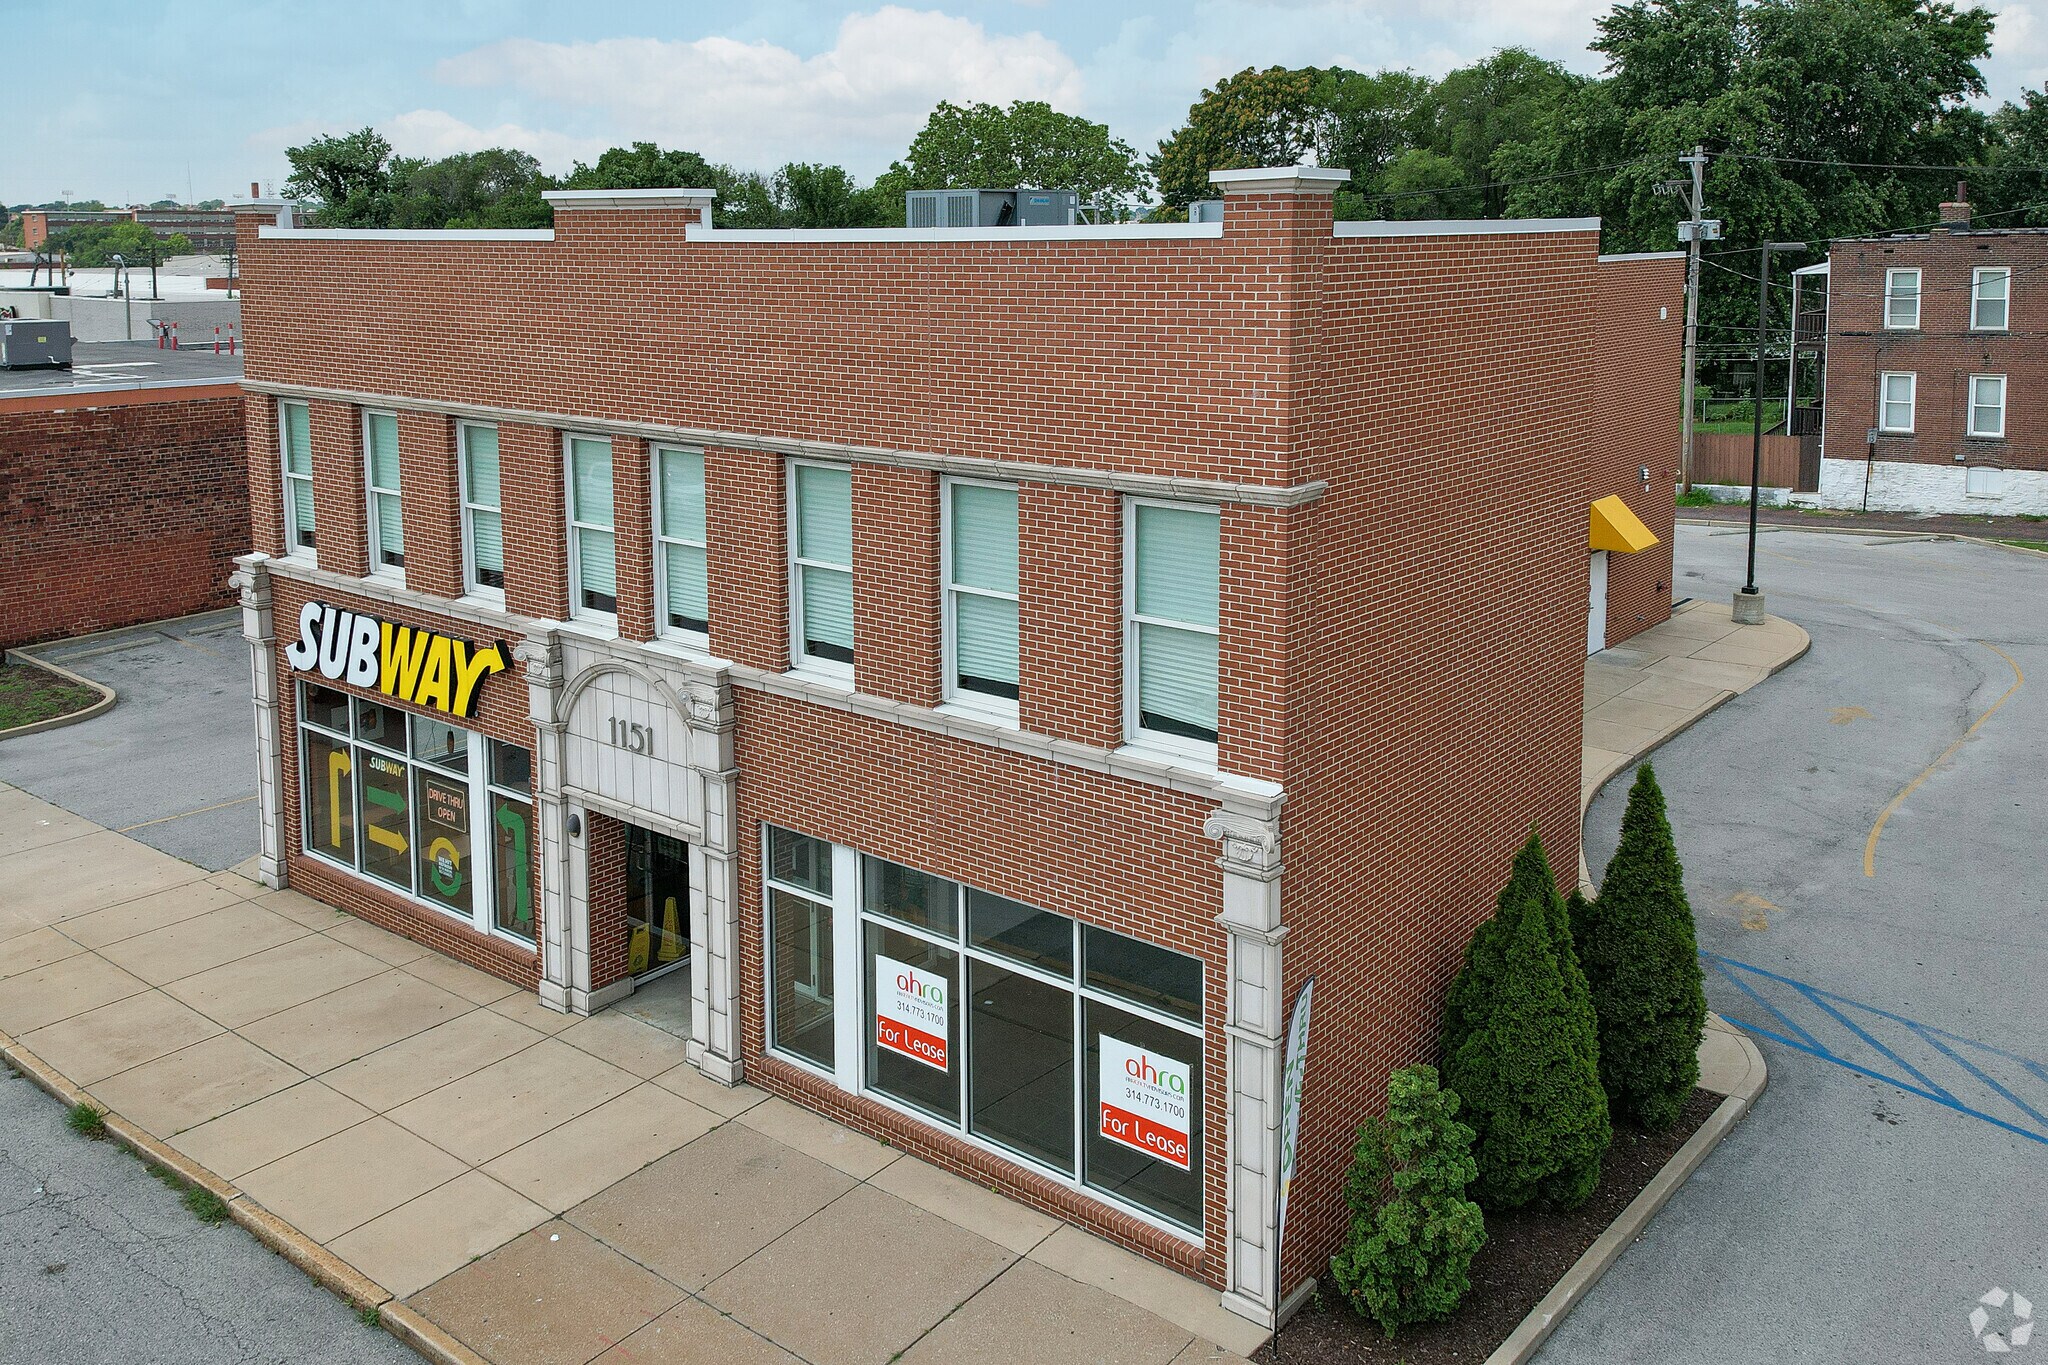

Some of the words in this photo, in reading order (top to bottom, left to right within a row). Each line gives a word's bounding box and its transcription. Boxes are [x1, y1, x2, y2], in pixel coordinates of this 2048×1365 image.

[285, 601, 507, 718] SUBWAY
[608, 716, 653, 755] 1151
[369, 756, 405, 777] SUBWAY
[429, 788, 447, 804] DRIVE
[447, 794, 464, 809] THRU
[437, 806, 456, 822] OPEN
[896, 970, 943, 1004] ahra
[897, 1000, 944, 1026] 314.773.1700
[904, 1029, 945, 1062] Lease
[1125, 1054, 1185, 1095] ahra
[1125, 1087, 1185, 1118] 314.773.1700
[1283, 1057, 1294, 1174] OPEN
[1135, 1120, 1187, 1159] Lease
